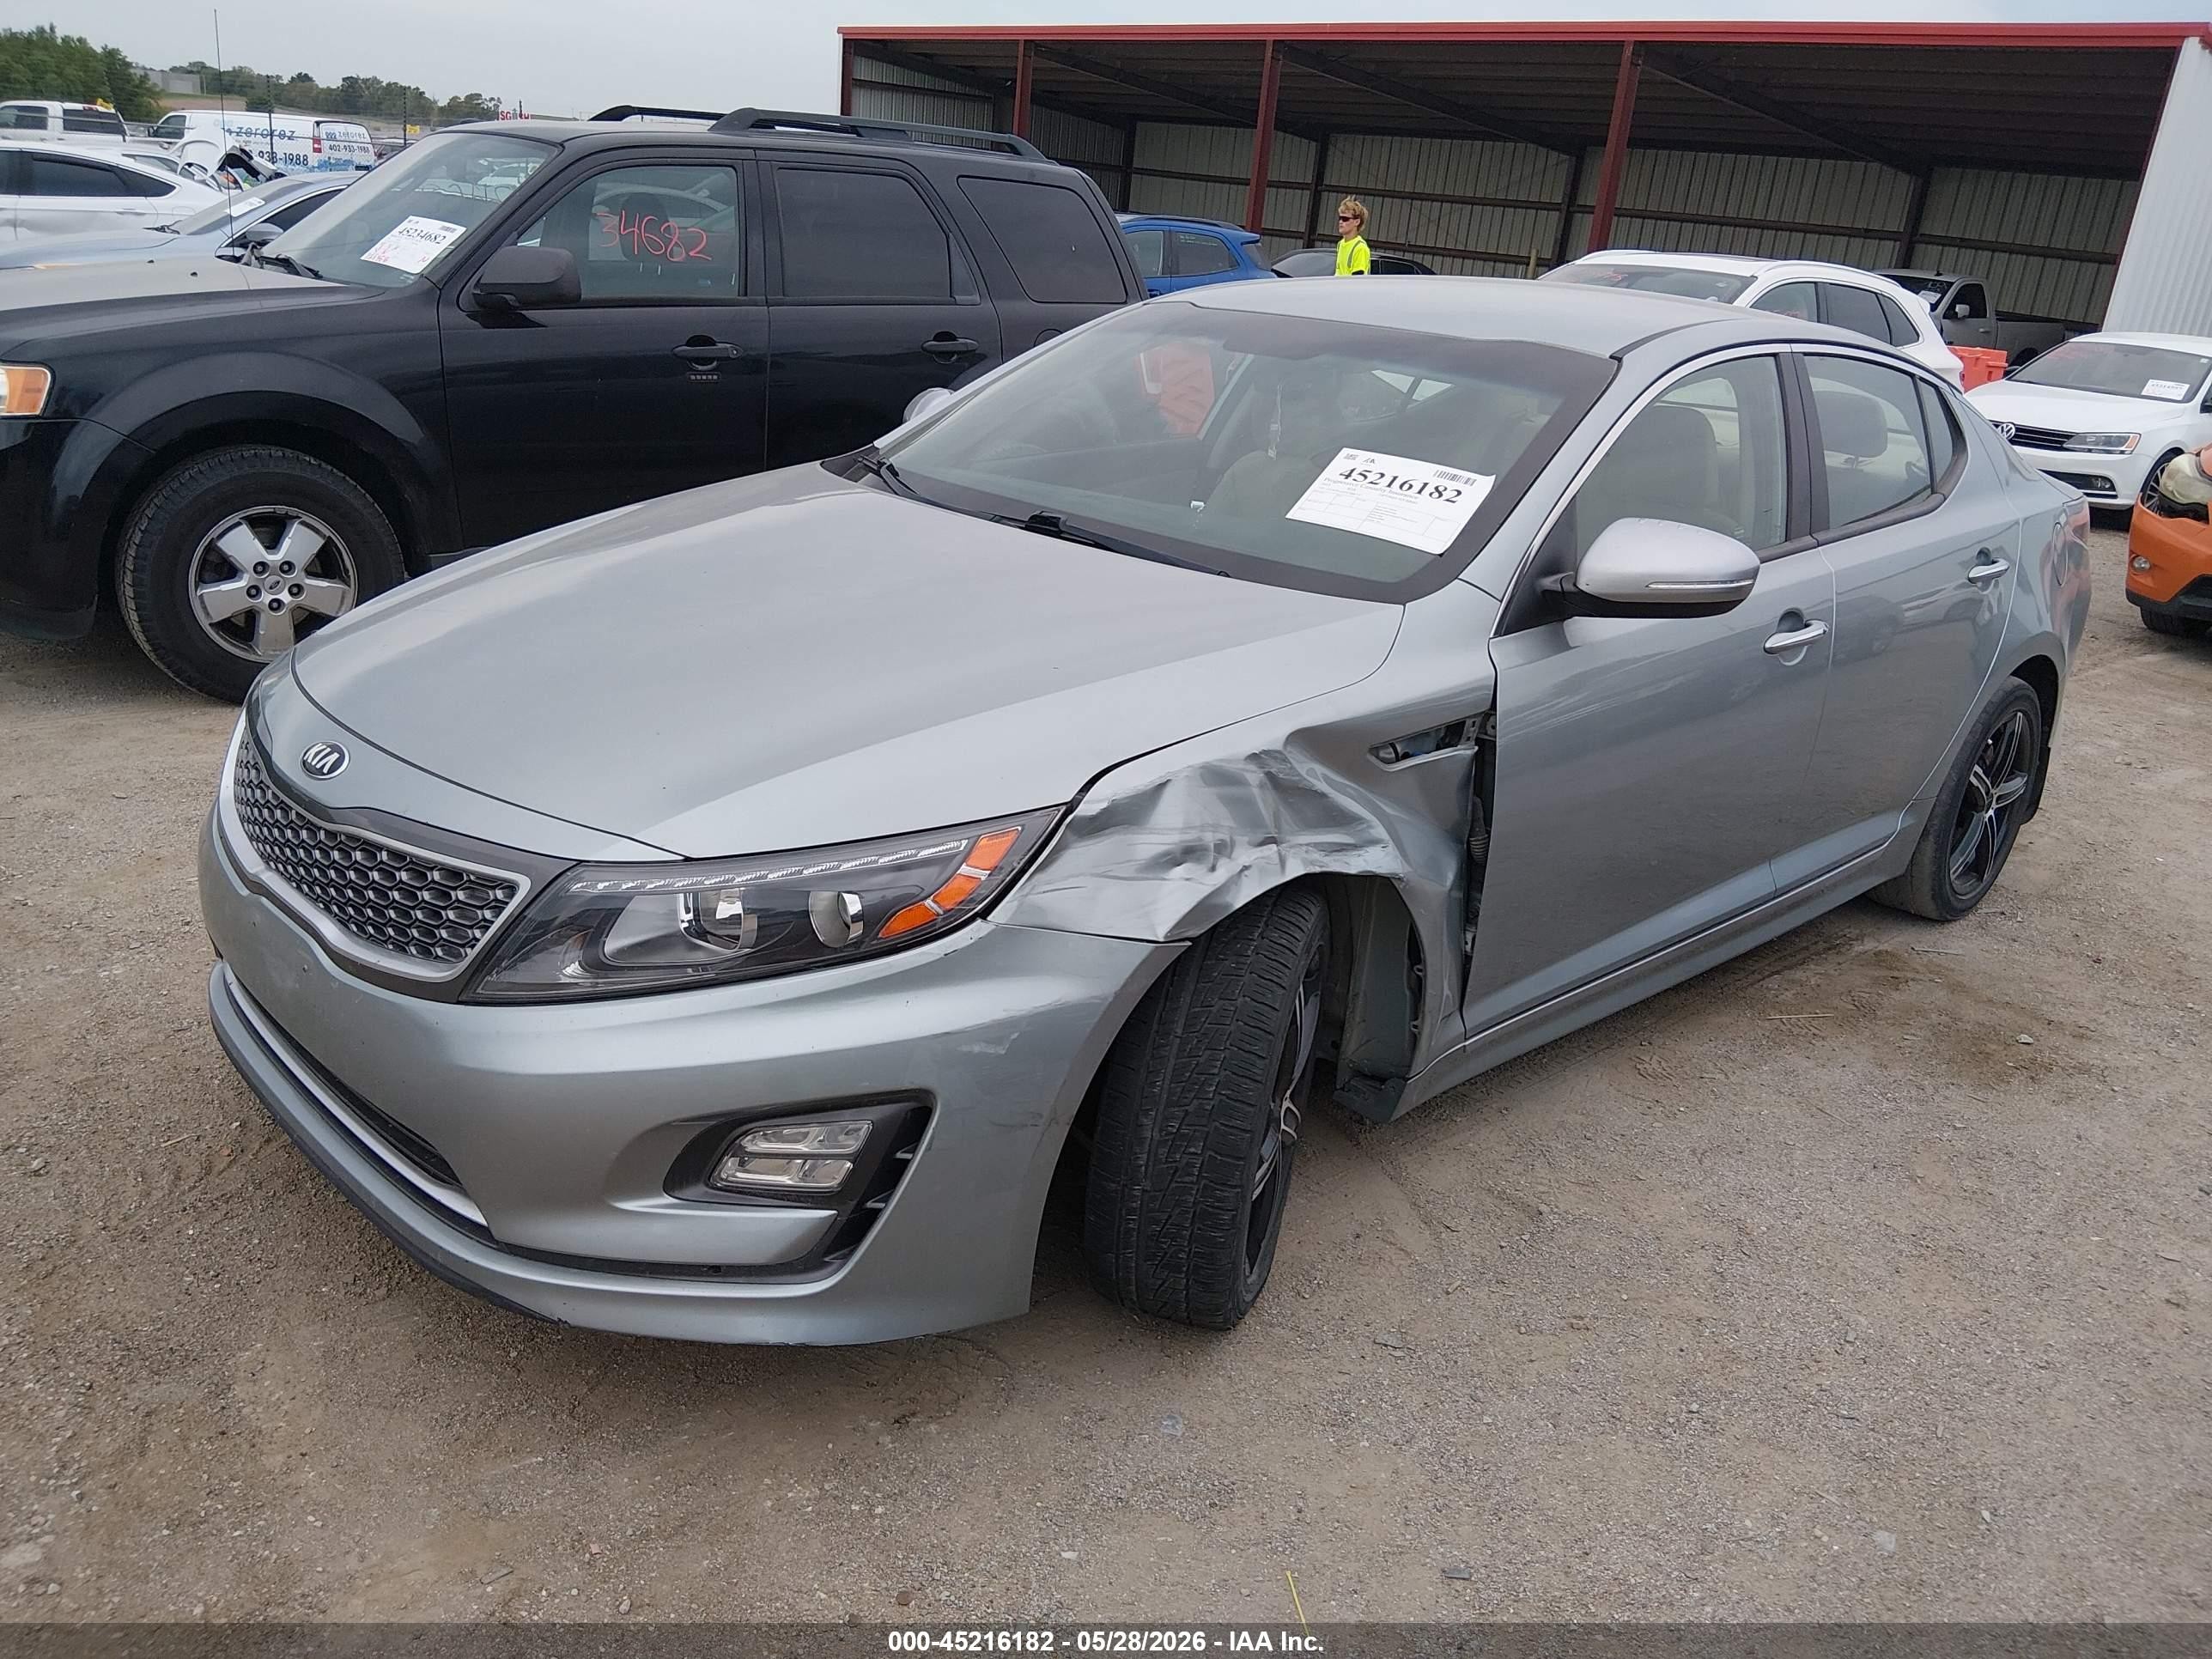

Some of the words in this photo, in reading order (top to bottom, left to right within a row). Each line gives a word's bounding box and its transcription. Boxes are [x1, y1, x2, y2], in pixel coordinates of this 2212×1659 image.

[236, 126, 295, 141] zerorez
[398, 226, 447, 245] 45234682
[595, 210, 713, 262] 34682
[1339, 467, 1463, 504] 45216182
[303, 743, 340, 775] KIA
